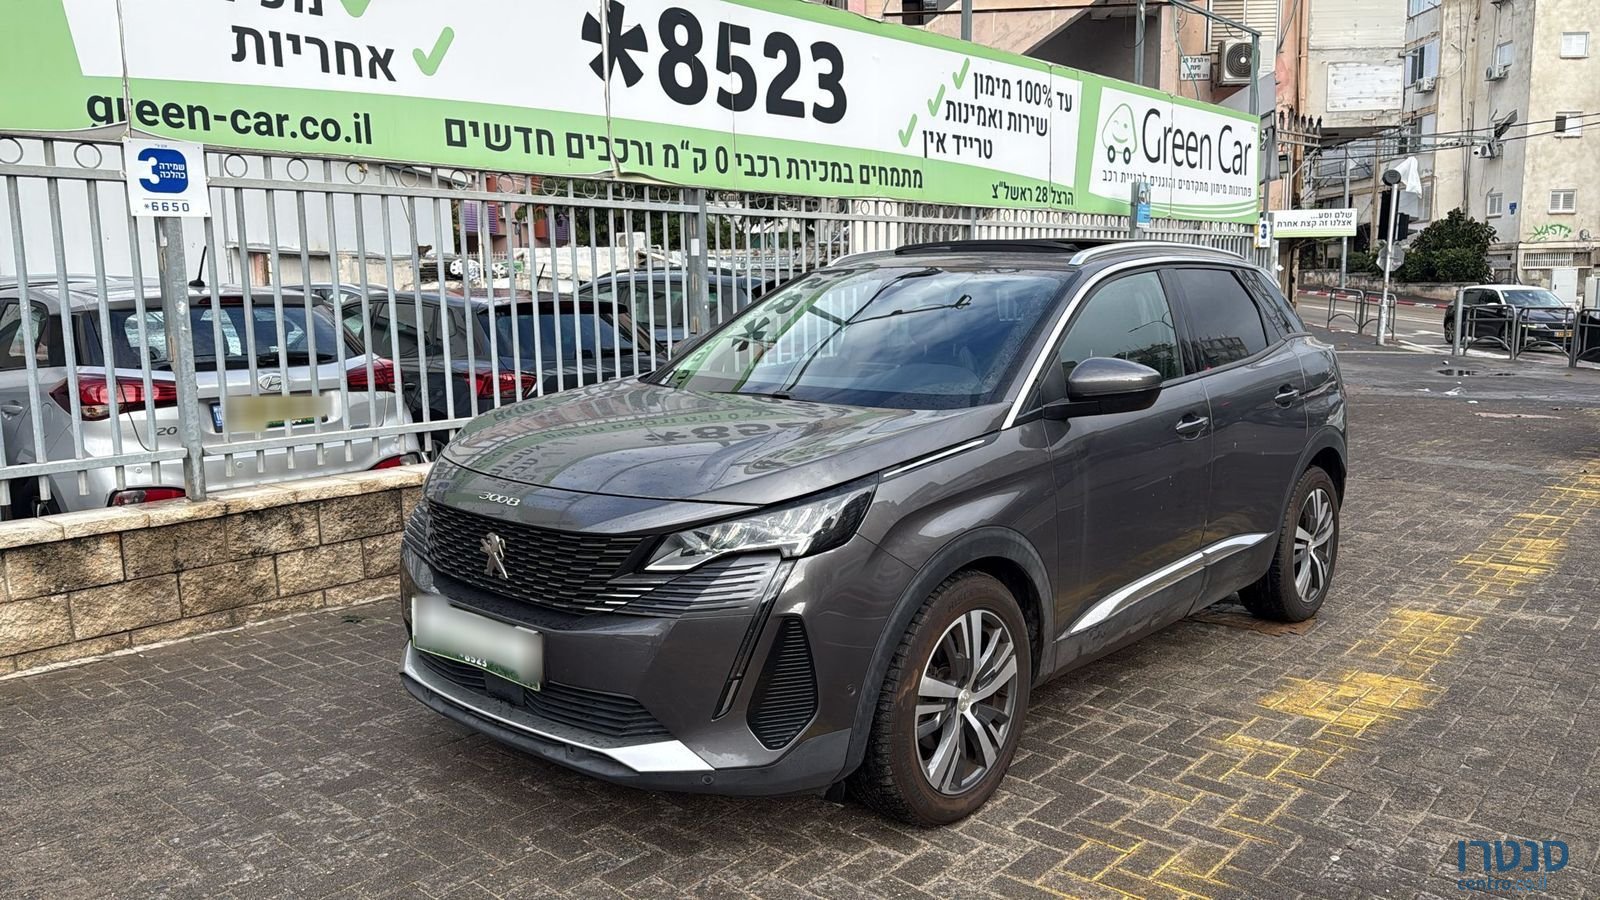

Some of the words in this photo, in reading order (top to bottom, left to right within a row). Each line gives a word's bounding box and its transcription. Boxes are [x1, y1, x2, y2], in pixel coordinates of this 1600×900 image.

[231, 25, 397, 82] אחריות
[974, 72, 1011, 100] מימון
[1016, 79, 1053, 108] 100%
[1056, 91, 1073, 112] עד
[86, 94, 373, 145] green-car.co.il
[945, 100, 1003, 129] ואמינות
[1007, 111, 1048, 136] שירות
[444, 118, 555, 156] חדשים
[565, 131, 654, 166] ורכבים
[922, 130, 947, 158] אין
[952, 134, 993, 159] טרייד
[1142, 108, 1211, 170] Green
[1218, 124, 1252, 175] Car
[159, 163, 185, 171] שמירה
[715, 145, 729, 174] 0
[735, 153, 780, 178] רכבי
[786, 157, 854, 184] במכירת
[160, 171, 186, 179] כהלכה
[859, 164, 924, 189] מתמחים
[1102, 169, 1118, 183] רכב
[1178, 179, 1209, 194] מתקדמים
[1035, 186, 1048, 203] 28
[1050, 186, 1073, 205] הרצל
[1210, 182, 1227, 196] מימון
[1300, 220, 1317, 228] קצת
[1330, 219, 1352, 227] אצלנו
[1334, 211, 1352, 219] שלם
[479, 491, 520, 506] 3008
